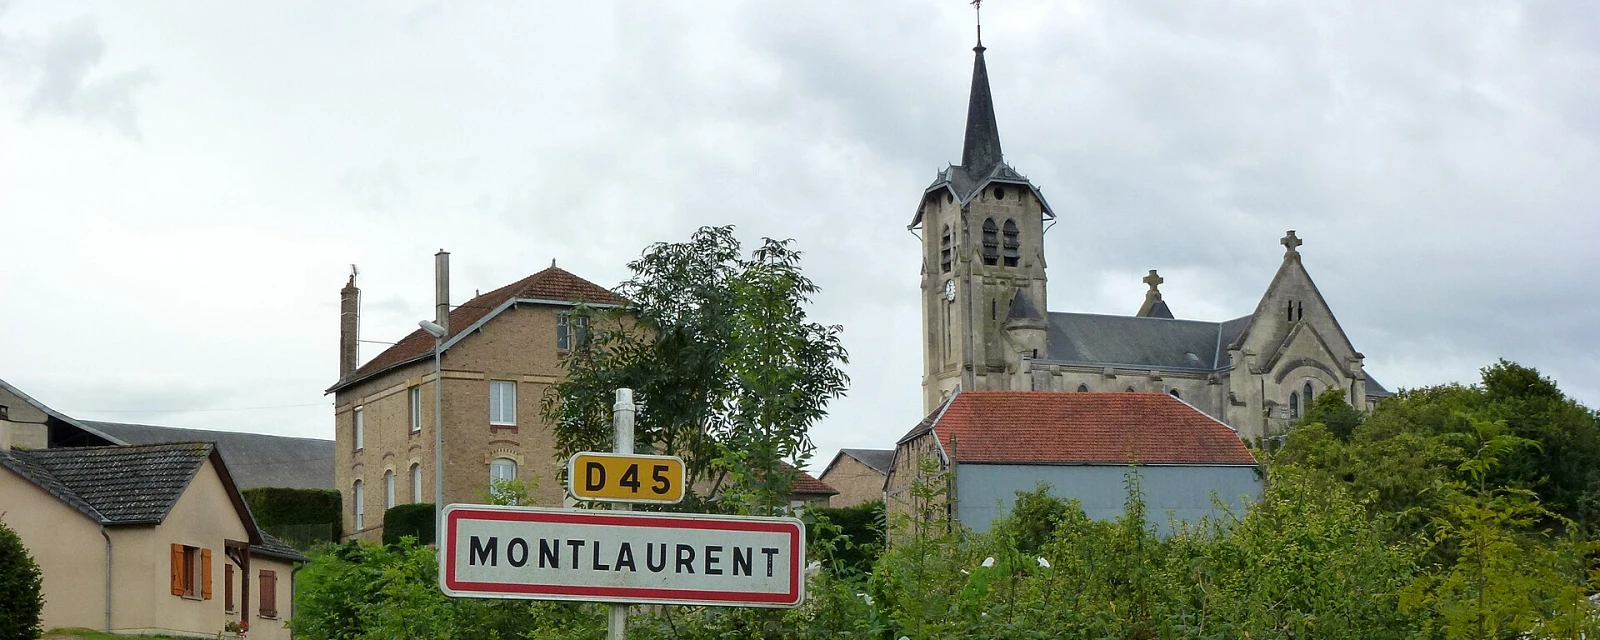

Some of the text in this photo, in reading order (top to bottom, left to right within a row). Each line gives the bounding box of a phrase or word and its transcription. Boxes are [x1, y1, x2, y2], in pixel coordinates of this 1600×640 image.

[585, 461, 672, 494] D 45
[468, 535, 779, 577] MONTLAURENT
